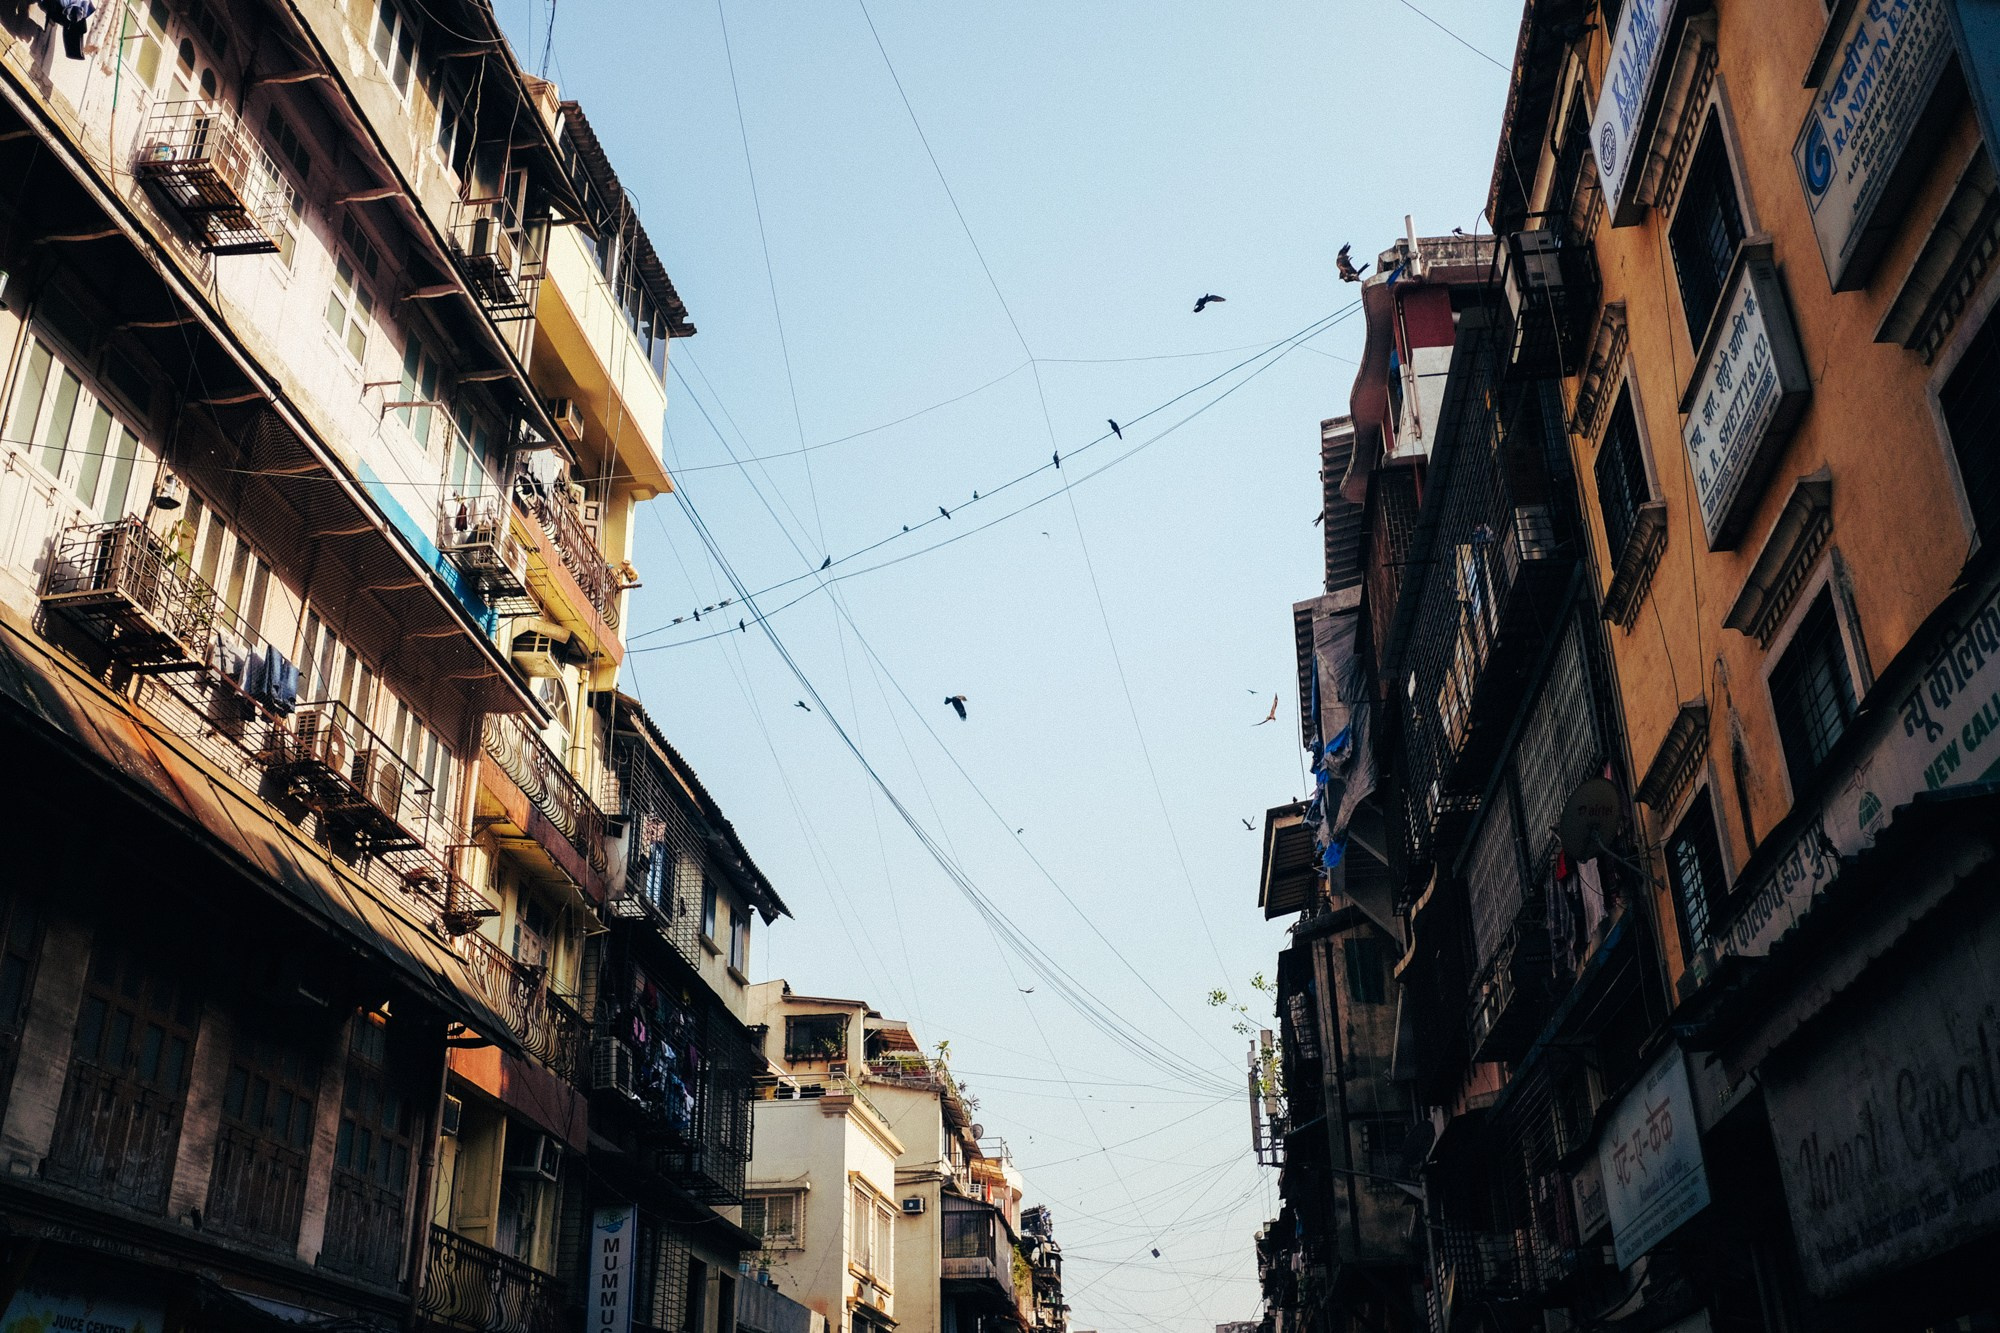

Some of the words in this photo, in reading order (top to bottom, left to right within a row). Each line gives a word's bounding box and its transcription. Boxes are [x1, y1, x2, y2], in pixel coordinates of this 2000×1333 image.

[1833, 27, 1890, 156] RANDWIN
[1848, 135, 1870, 184] ALVES
[1869, 22, 1921, 137] HEALTHCARE
[1851, 74, 1885, 150] GOLDWIN
[1862, 127, 1885, 172] MEGA
[1702, 389, 1720, 425] आर.
[1728, 314, 1749, 360] आणि
[1699, 469, 1711, 495] H.
[1709, 448, 1721, 475] R.
[1719, 376, 1750, 454] SHETTY
[1747, 364, 1757, 388] &
[1752, 333, 1769, 366] CO.
[1730, 417, 1754, 468] SOLICITORS
[1923, 738, 1961, 791] NEW
[1589, 804, 1613, 816] airtel
[52, 1314, 85, 1332] JUICE
